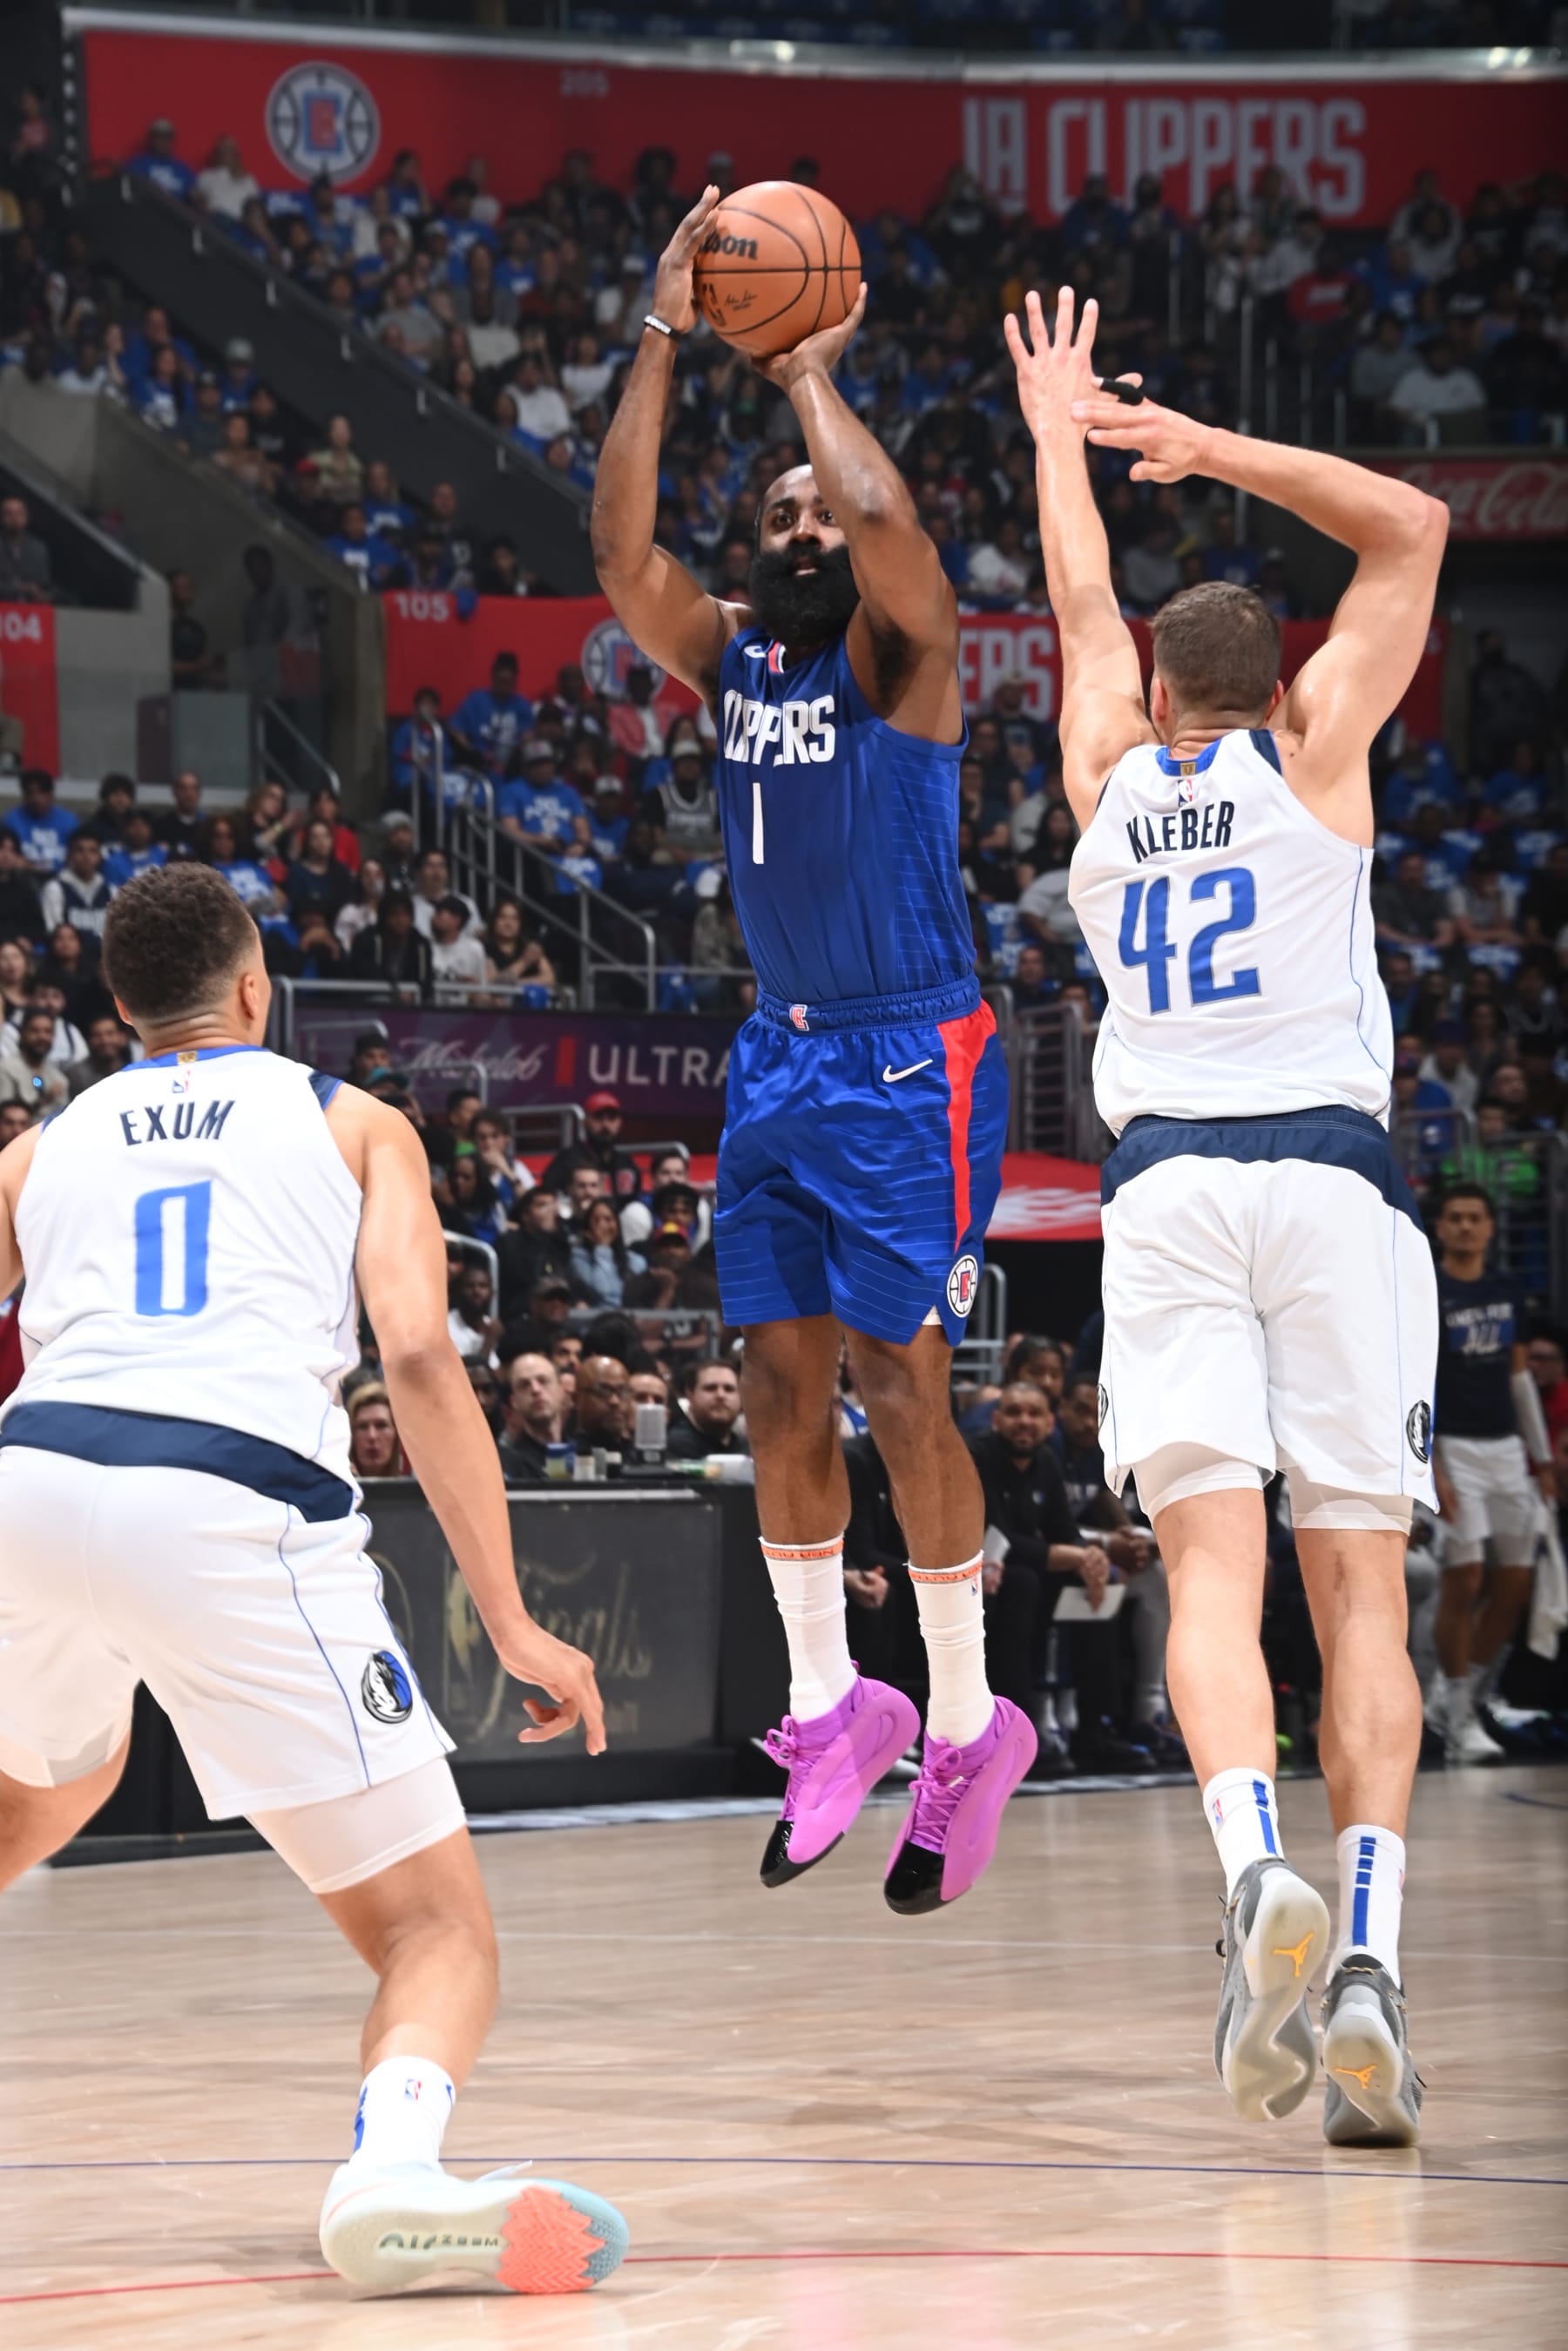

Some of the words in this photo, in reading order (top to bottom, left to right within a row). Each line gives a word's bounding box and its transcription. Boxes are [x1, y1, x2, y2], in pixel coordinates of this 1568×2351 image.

[0, 611, 41, 643] 04
[395, 593, 449, 622] 105
[724, 689, 836, 767] CLIPPRS
[753, 782, 764, 864] 1
[1126, 801, 1235, 864] KLEBER
[1119, 867, 1261, 1017] 42
[119, 1100, 236, 1146] EXUM
[134, 1179, 213, 1318] 0
